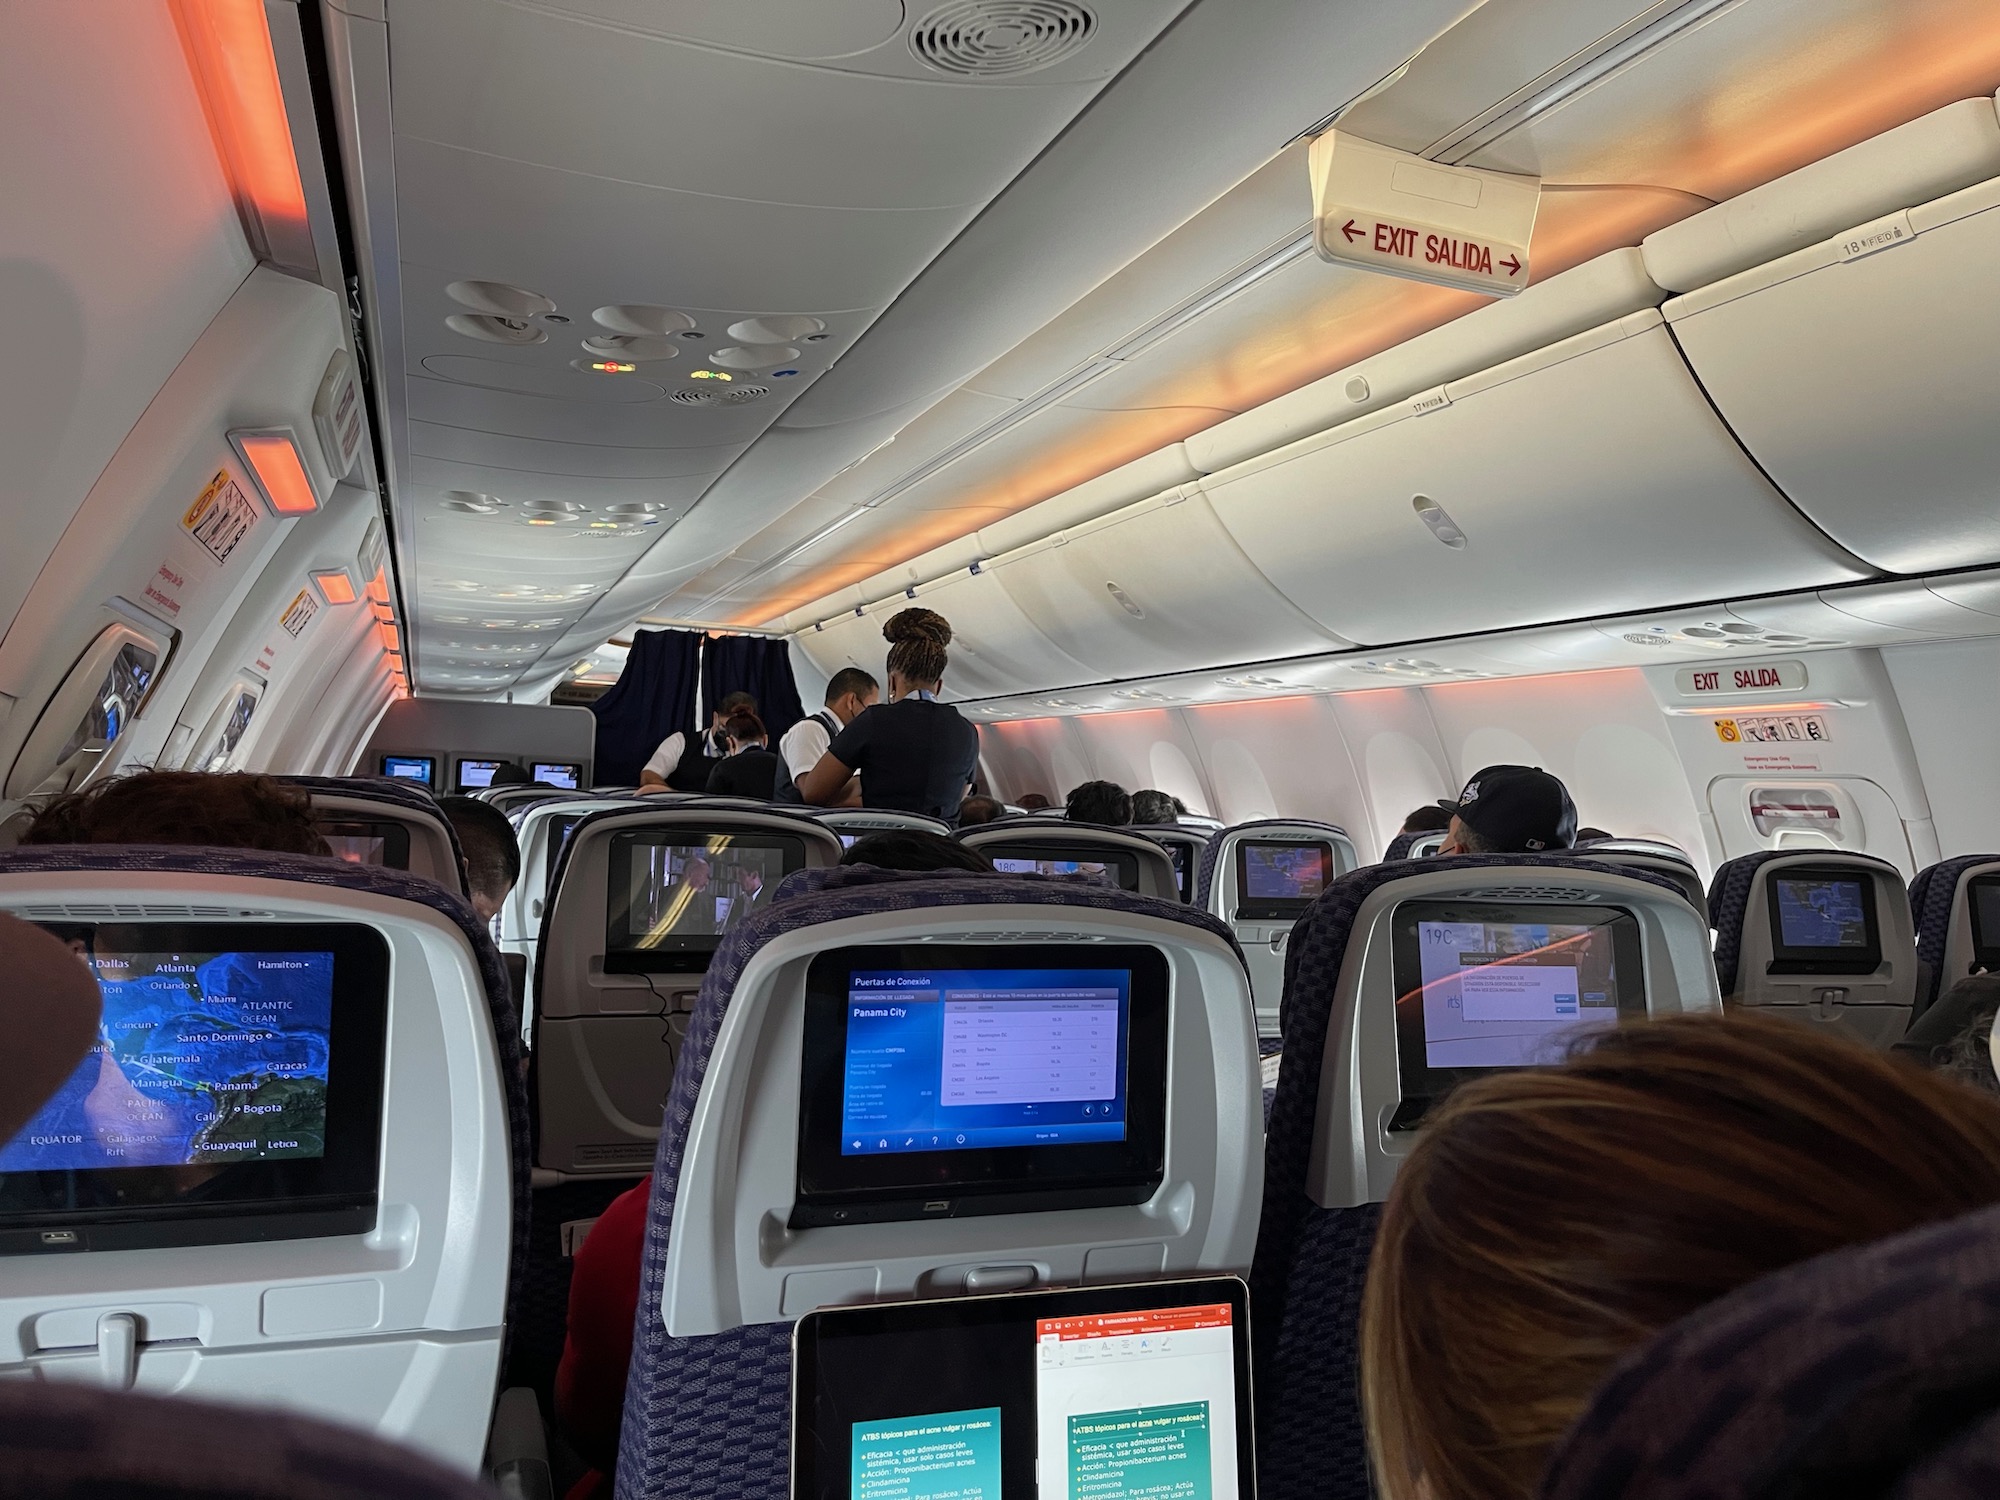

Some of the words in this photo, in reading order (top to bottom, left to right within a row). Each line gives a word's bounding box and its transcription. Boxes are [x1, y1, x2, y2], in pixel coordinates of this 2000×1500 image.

[1375, 223, 1418, 258] EXIT
[1425, 234, 1493, 275] SALIDA
[1843, 241, 1860, 255] 18
[1413, 403, 1422, 412] 17
[1693, 672, 1719, 691] EXIT
[1734, 668, 1781, 688] SALIDA
[1426, 928, 1453, 945] 19C
[95, 959, 129, 969] Dallas
[155, 963, 196, 973] Atlanta
[257, 960, 302, 970] Hamilton
[150, 981, 190, 990] Orlando
[854, 977, 885, 986] Puertas
[886, 978, 896, 986] de
[897, 977, 931, 986] Conexión
[207, 995, 236, 1003] Miami
[241, 1001, 293, 1010] ATLANTIC
[853, 1008, 889, 1018] Panama
[889, 1007, 907, 1018] City
[240, 1014, 277, 1024] OCEAN
[114, 1021, 152, 1030] Cancun
[176, 1033, 209, 1043] Santo
[211, 1032, 263, 1044] Domingo
[266, 1061, 308, 1071] Caracas
[131, 1078, 183, 1089] Managua
[214, 1080, 258, 1091] Panama
[127, 1099, 167, 1108] PACIFIC
[243, 1102, 282, 1114] Bogota
[126, 1111, 164, 1122] OCEAN
[195, 1111, 217, 1122] Cali
[30, 1135, 82, 1145] EQUATOR
[106, 1133, 158, 1144] Galapagos
[267, 1138, 298, 1149] Leticia
[201, 1138, 257, 1151] Guayaquil
[106, 1147, 125, 1157] Rift
[861, 1432, 881, 1442] ATBS
[881, 1431, 903, 1440] tópicos
[904, 1429, 919, 1438] para
[926, 1427, 941, 1435] acne
[942, 1424, 961, 1433] vulgar
[961, 1424, 966, 1432] y
[966, 1420, 992, 1430] rosácea:
[1076, 1426, 1094, 1435] ATBS
[1095, 1422, 1116, 1433] tópicos
[1117, 1422, 1131, 1431] para
[1131, 1420, 1137, 1428] el
[1138, 1420, 1153, 1428] acne
[1153, 1417, 1172, 1427] vulgar
[1172, 1418, 1177, 1426] y
[1082, 1443, 1107, 1453] Eficacia
[1115, 1441, 1129, 1449] que
[1130, 1434, 1178, 1447] administración
[866, 1449, 893, 1460] Eficacia
[902, 1448, 916, 1456] que
[917, 1440, 966, 1454] administración
[1081, 1450, 1115, 1461] sistémica,
[1116, 1449, 1131, 1457] usar
[1132, 1446, 1147, 1455] solo
[1147, 1445, 1166, 1453] casos
[1167, 1442, 1184, 1451] leves
[866, 1458, 902, 1468] sistémica,
[903, 1455, 919, 1463] usar
[920, 1453, 934, 1461] solo
[935, 1451, 954, 1459] casos
[955, 1448, 974, 1457] leves
[1081, 1462, 1106, 1472] Acción:
[1108, 1454, 1167, 1468] Propionibacterium
[1168, 1452, 1187, 1461] acnes
[866, 1469, 892, 1478] Acción:
[894, 1460, 955, 1475] Propionibacterium
[956, 1458, 976, 1467] acnes
[1082, 1470, 1124, 1481] Clindamicina
[866, 1477, 911, 1489] Clindamicina
[1082, 1481, 1122, 1492] Eritromicina
[866, 1486, 908, 1499] Eritromicina
[963, 1486, 982, 1496] Actúa
[1082, 1489, 1128, 1500] Metronidazol;
[1129, 1488, 1145, 1496] Para
[1146, 1484, 1173, 1494] rosácea;
[1174, 1480, 1193, 1490] Actúa
[1160, 1492, 1169, 1500] no
[1170, 1491, 1186, 1499] usar
[1186, 1489, 1195, 1497] en
